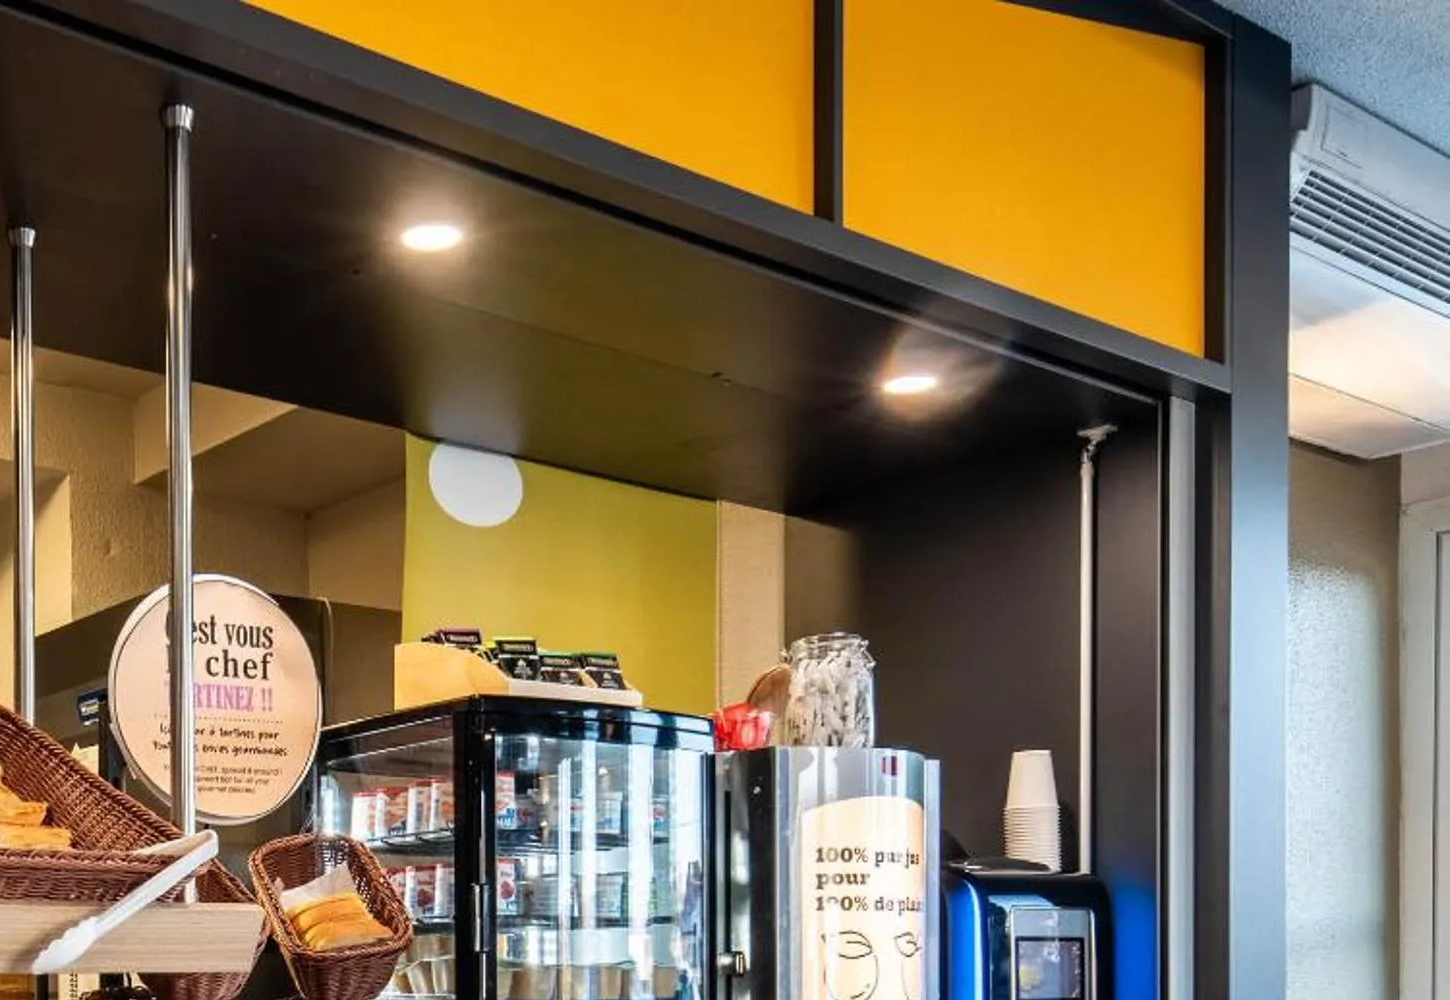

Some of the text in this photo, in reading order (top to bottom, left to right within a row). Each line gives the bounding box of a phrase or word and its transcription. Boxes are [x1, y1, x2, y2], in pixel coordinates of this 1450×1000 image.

[224, 623, 274, 650] vous
[206, 648, 274, 681] chef
[815, 847, 869, 863] 100%
[815, 872, 871, 890] pour
[874, 896, 895, 912] de
